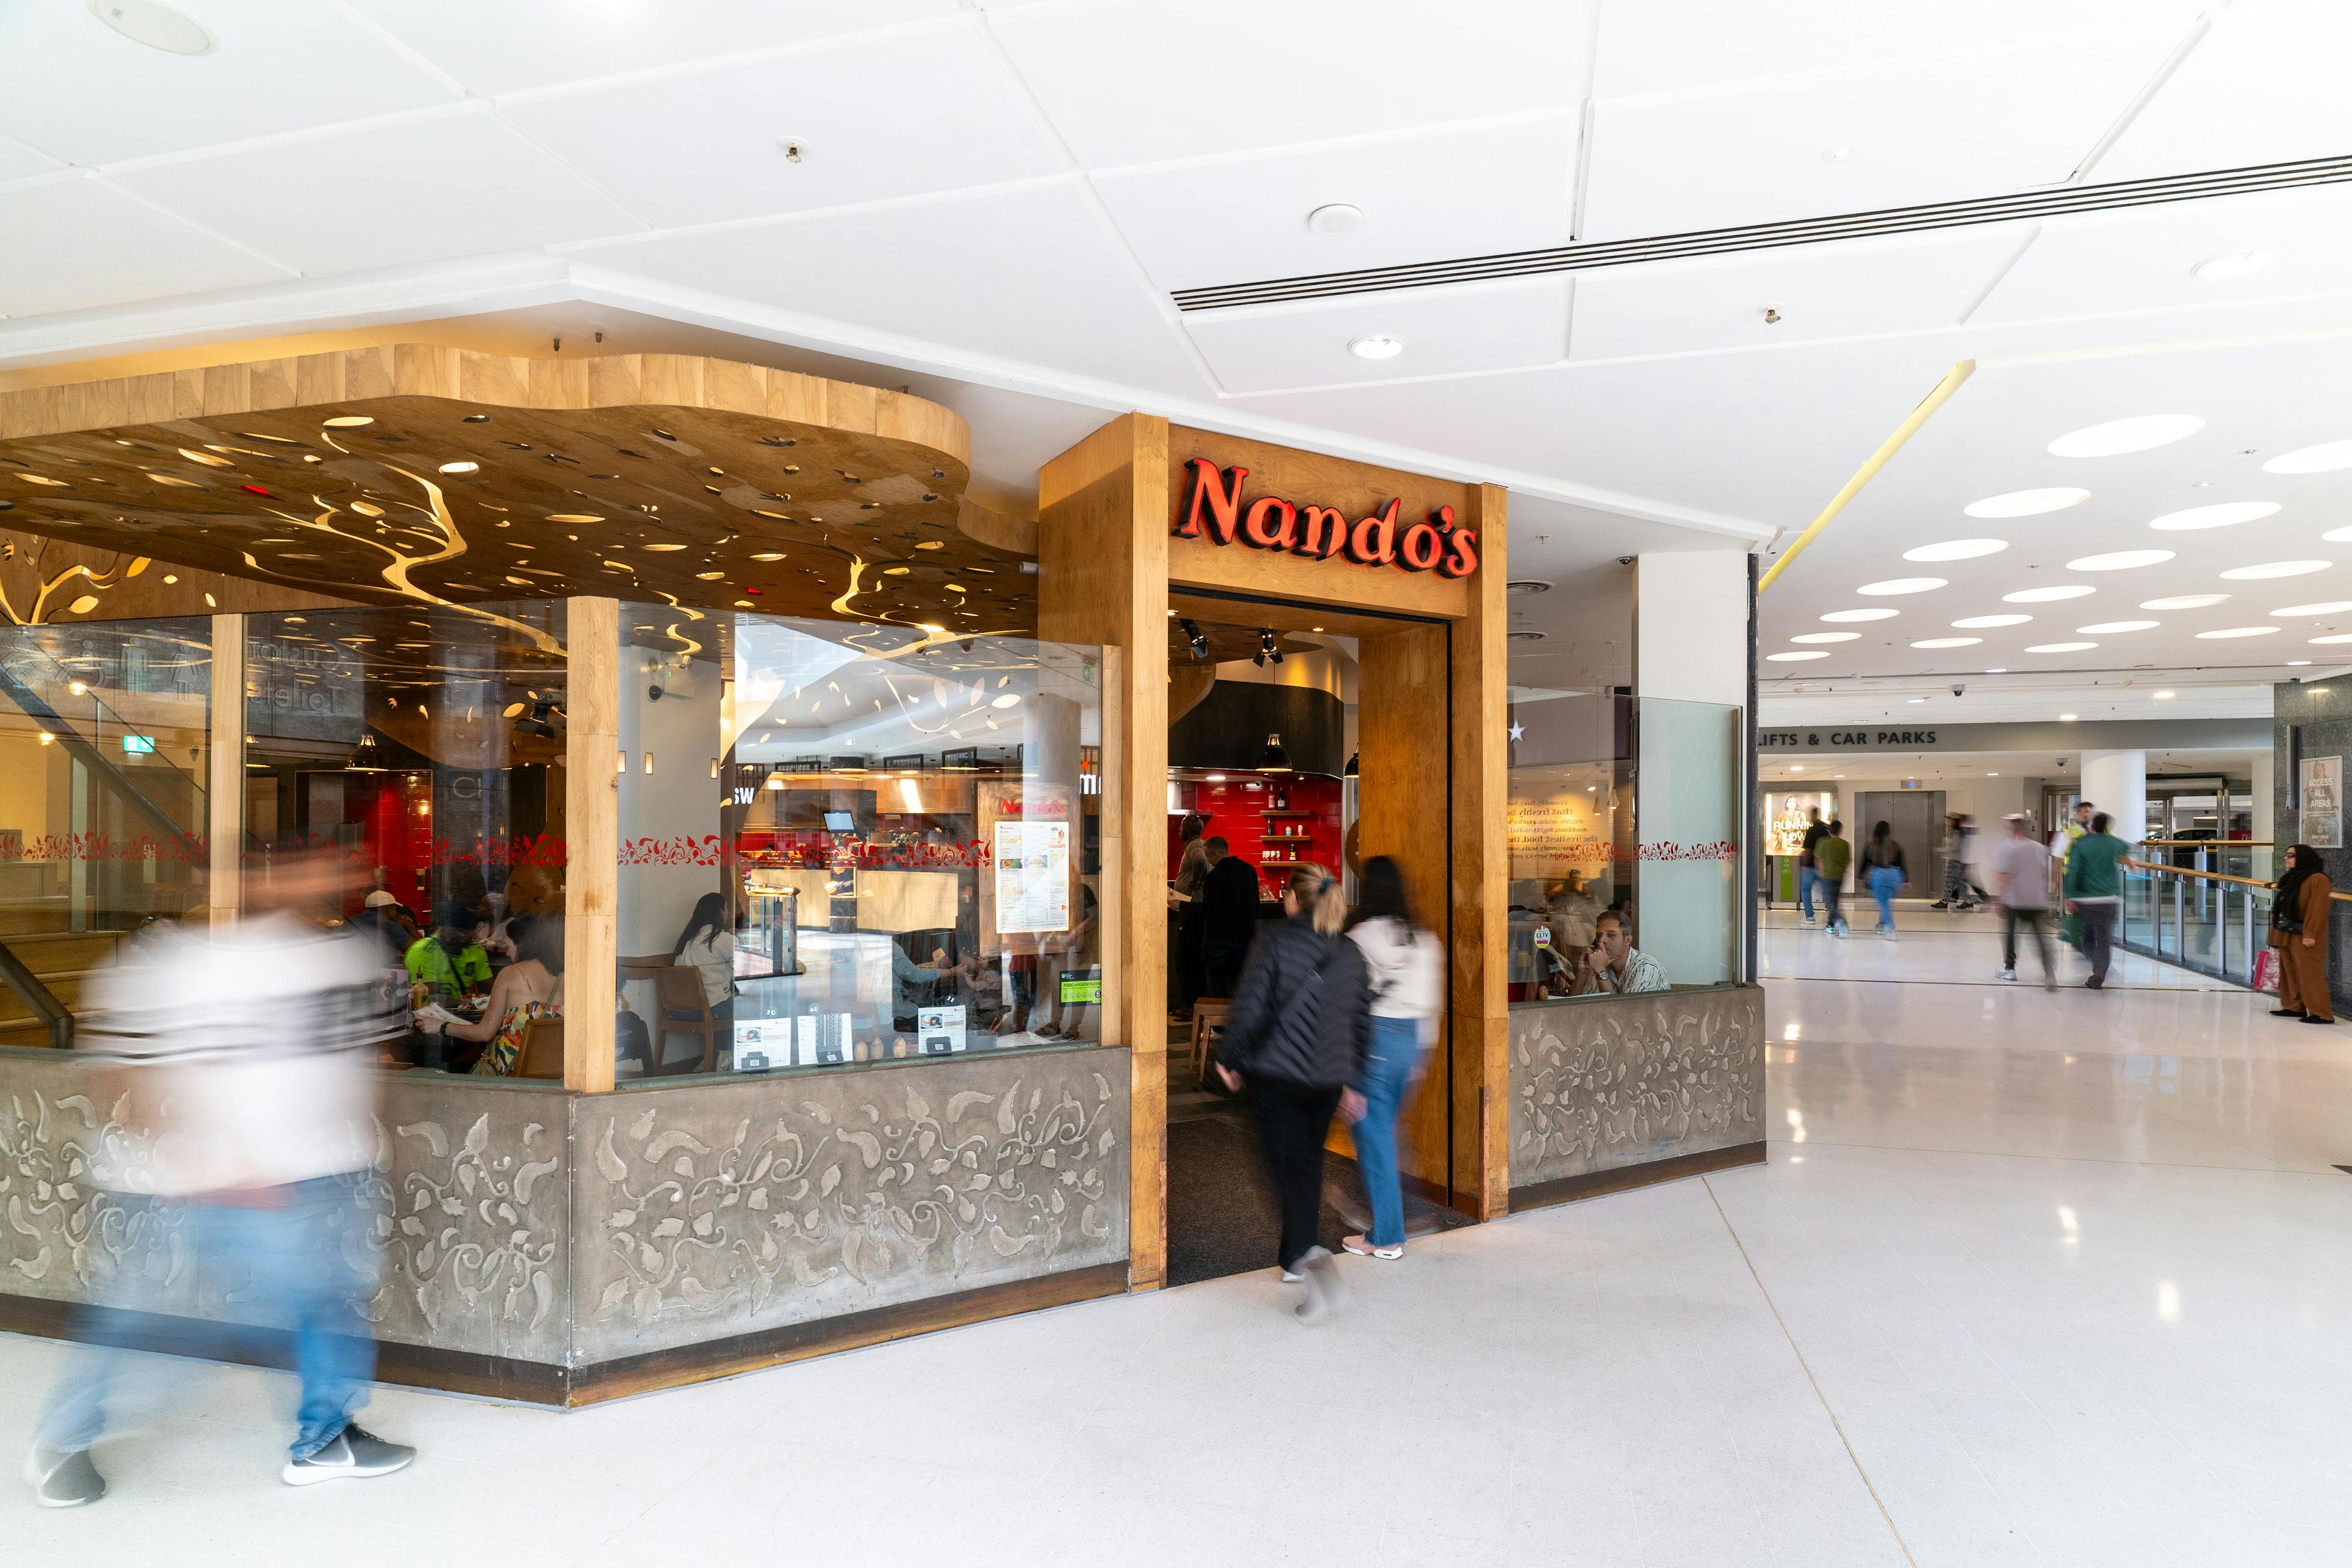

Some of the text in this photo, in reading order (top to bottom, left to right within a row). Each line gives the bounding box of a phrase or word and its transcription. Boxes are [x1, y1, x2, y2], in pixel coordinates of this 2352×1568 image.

[1171, 458, 1479, 579] Nando's
[1807, 734, 1819, 745] &
[1831, 733, 1867, 745] CAR
[1878, 731, 1936, 744] PARKS
[2309, 777, 2333, 787] ACCESS
[1000, 799, 1065, 814] Nando's
[2310, 799, 2331, 808] AREAS
[1773, 821, 1814, 830] RUNNIN
[1782, 832, 1806, 841] LOW
